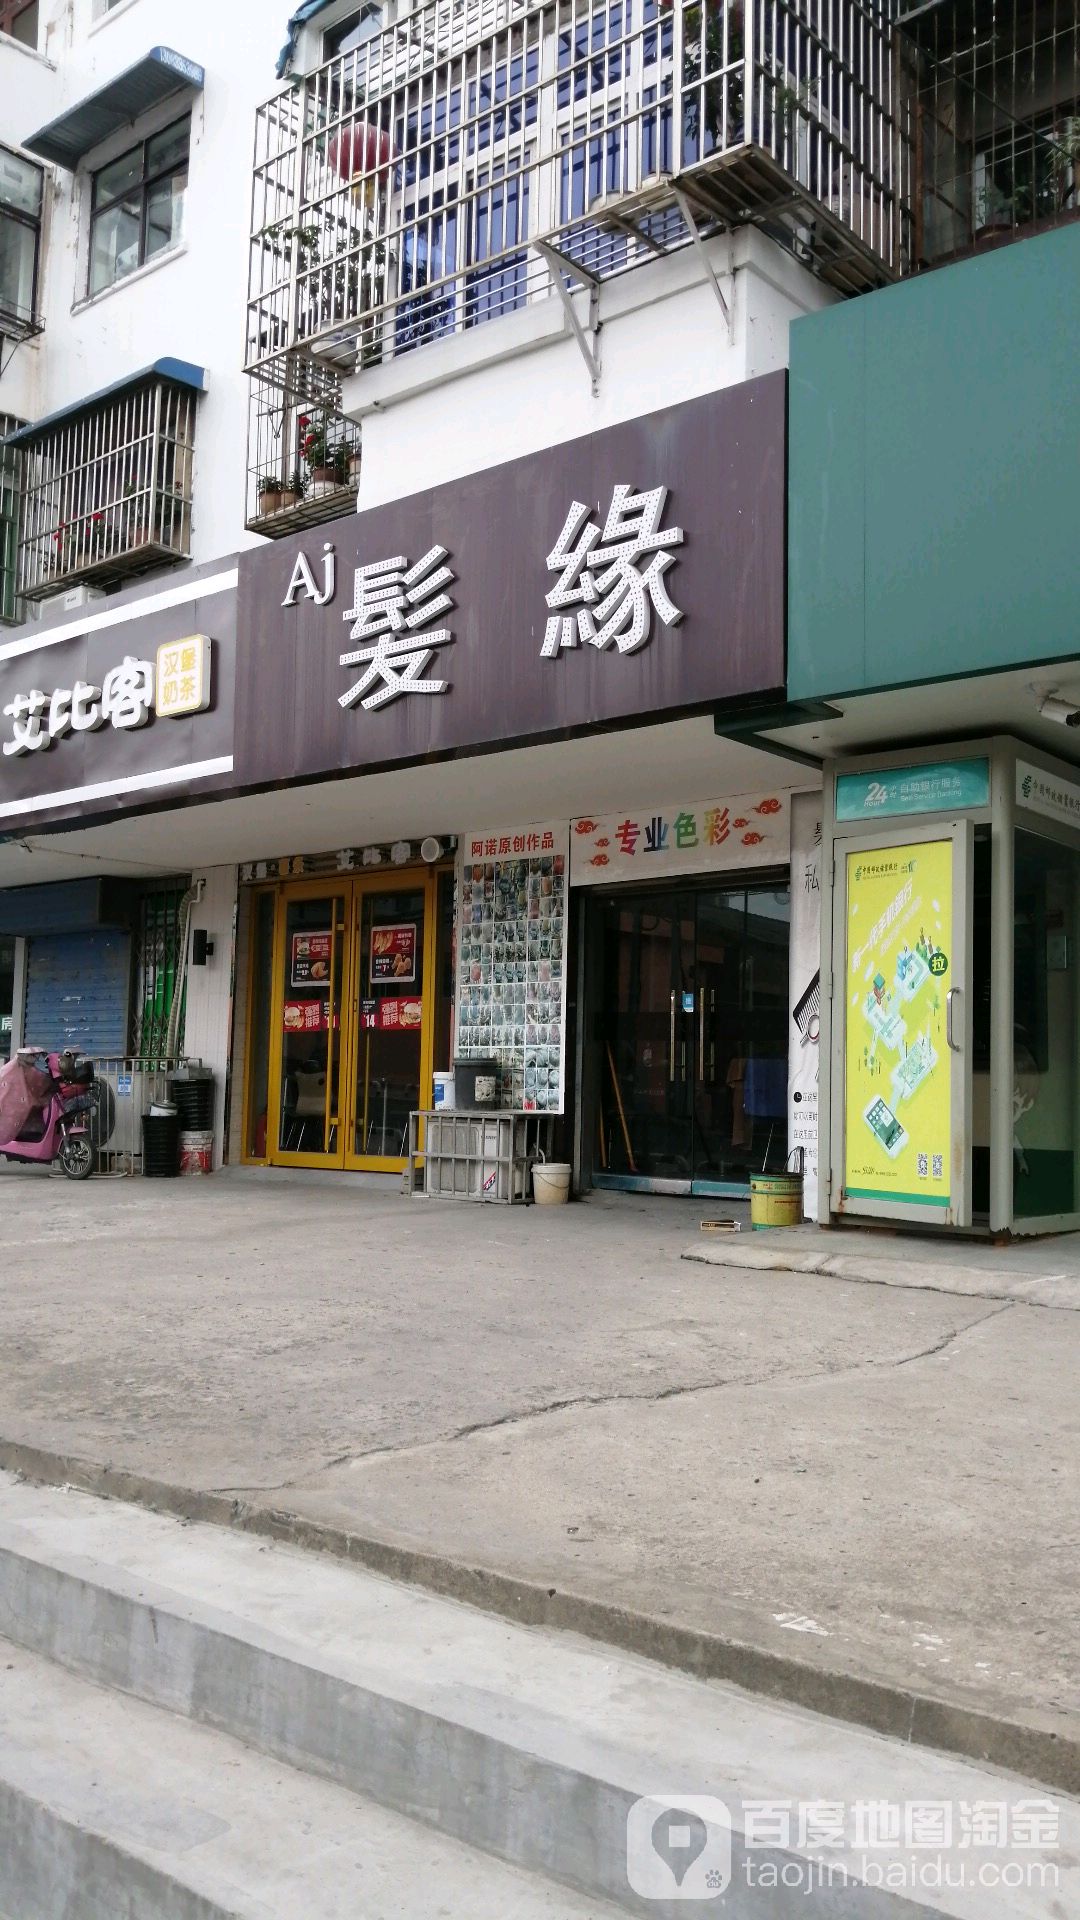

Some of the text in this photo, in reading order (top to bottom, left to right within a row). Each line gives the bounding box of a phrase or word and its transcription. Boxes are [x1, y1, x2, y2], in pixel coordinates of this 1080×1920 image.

[281, 542, 335, 607] Aj
[163, 648, 196, 677] 汉堡
[3, 655, 155, 756] 艾比客
[162, 675, 195, 706] 奶茶
[865, 782, 888, 804] 24
[900, 776, 961, 794] 自助银行服务
[471, 831, 554, 857] 阿诺原创作品
[614, 807, 730, 856] 专业色彩
[932, 956, 945, 972] 拉
